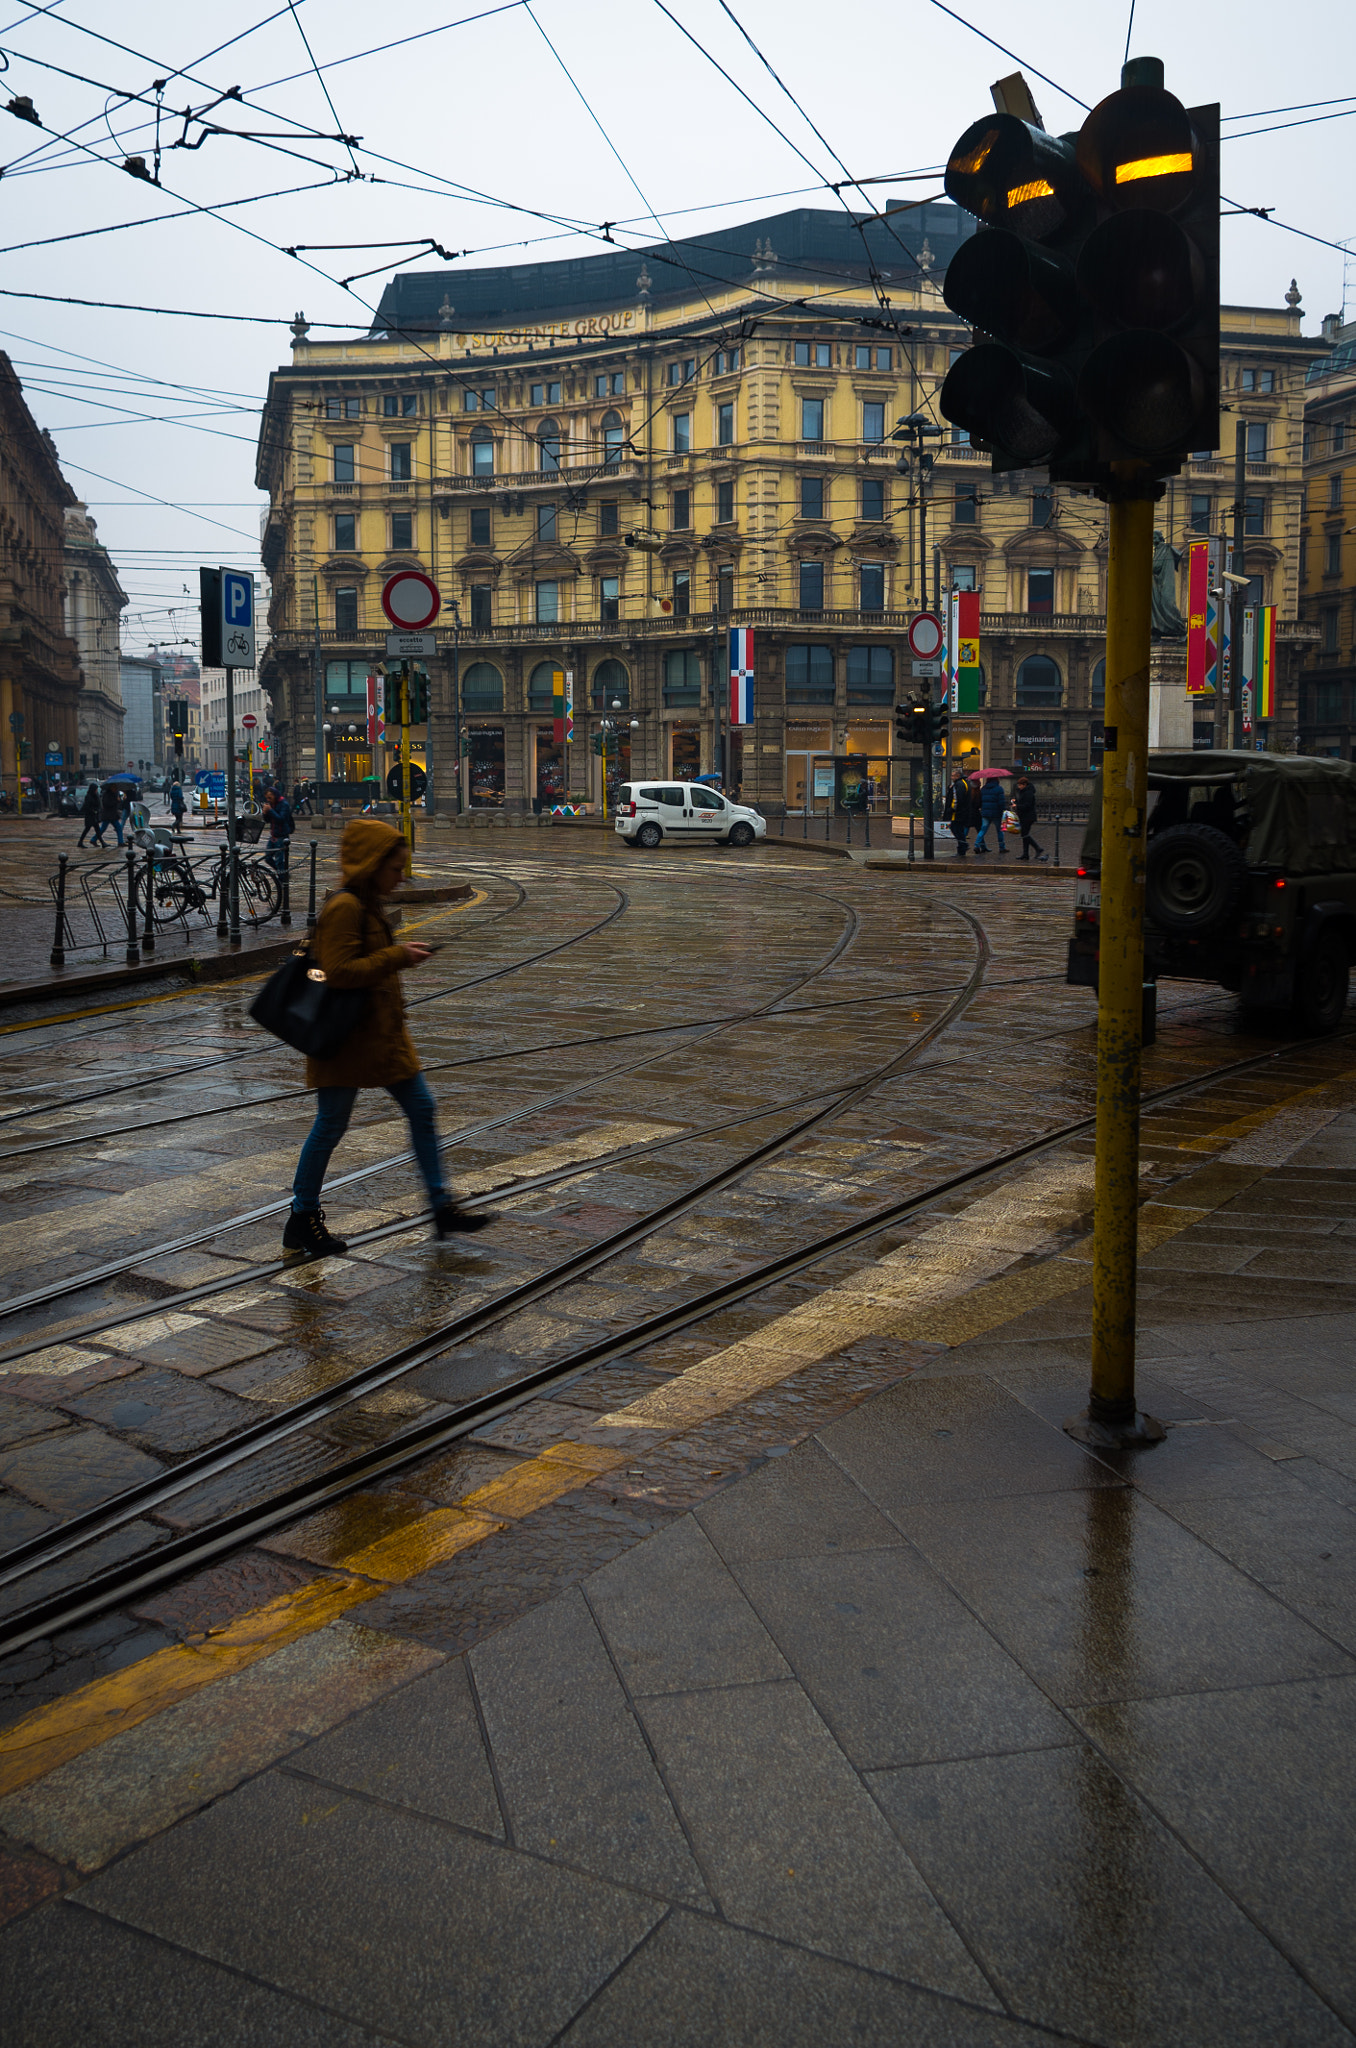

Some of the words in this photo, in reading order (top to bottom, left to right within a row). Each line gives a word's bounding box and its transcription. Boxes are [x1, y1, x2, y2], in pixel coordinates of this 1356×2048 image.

[471, 321, 570, 349] SORGENTE
[574, 311, 633, 336] GROUP
[231, 582, 246, 618] P
[1017, 735, 1055, 744] Imaginarium
